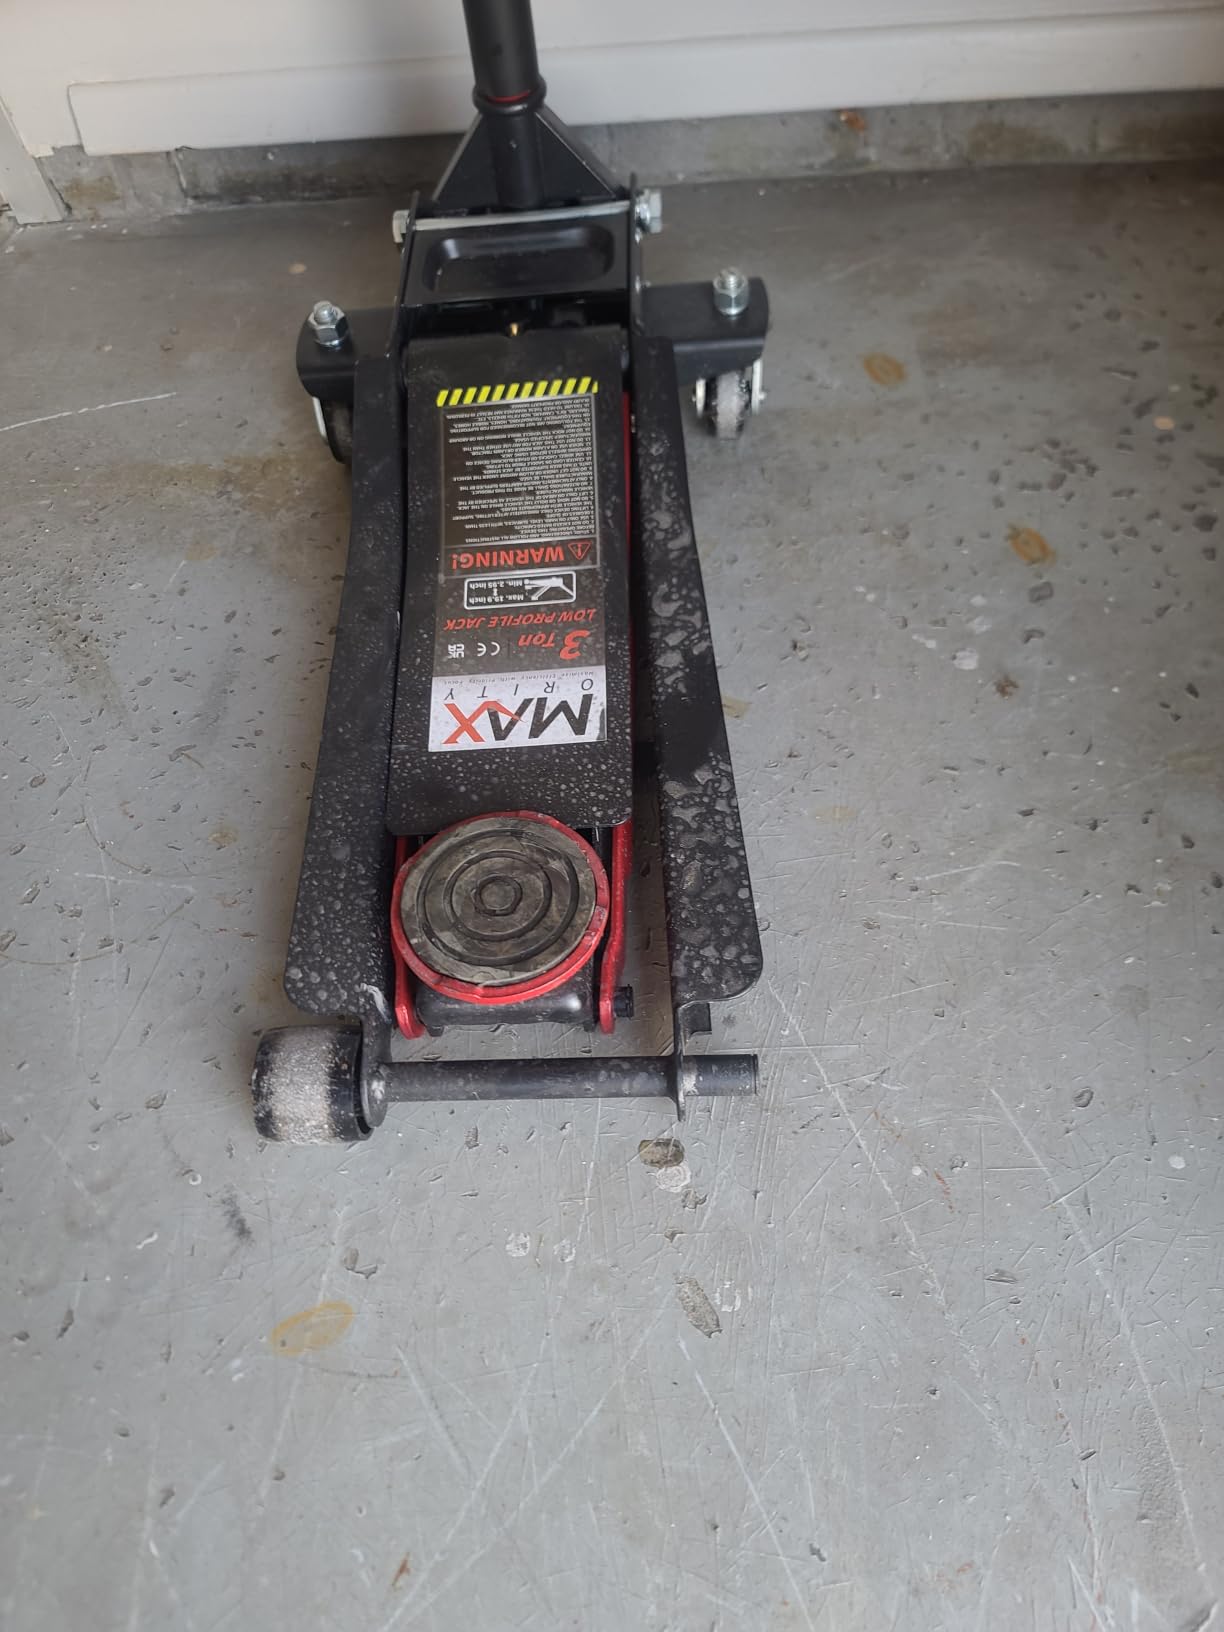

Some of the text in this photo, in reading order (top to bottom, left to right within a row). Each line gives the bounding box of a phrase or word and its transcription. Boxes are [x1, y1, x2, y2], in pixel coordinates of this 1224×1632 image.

[452, 546, 564, 570] WARNING!
[486, 595, 504, 603] 19.9
[444, 608, 596, 630] LOW PROFILE JACK
[518, 630, 590, 660] 3 Ton
[442, 694, 593, 744] MAX
